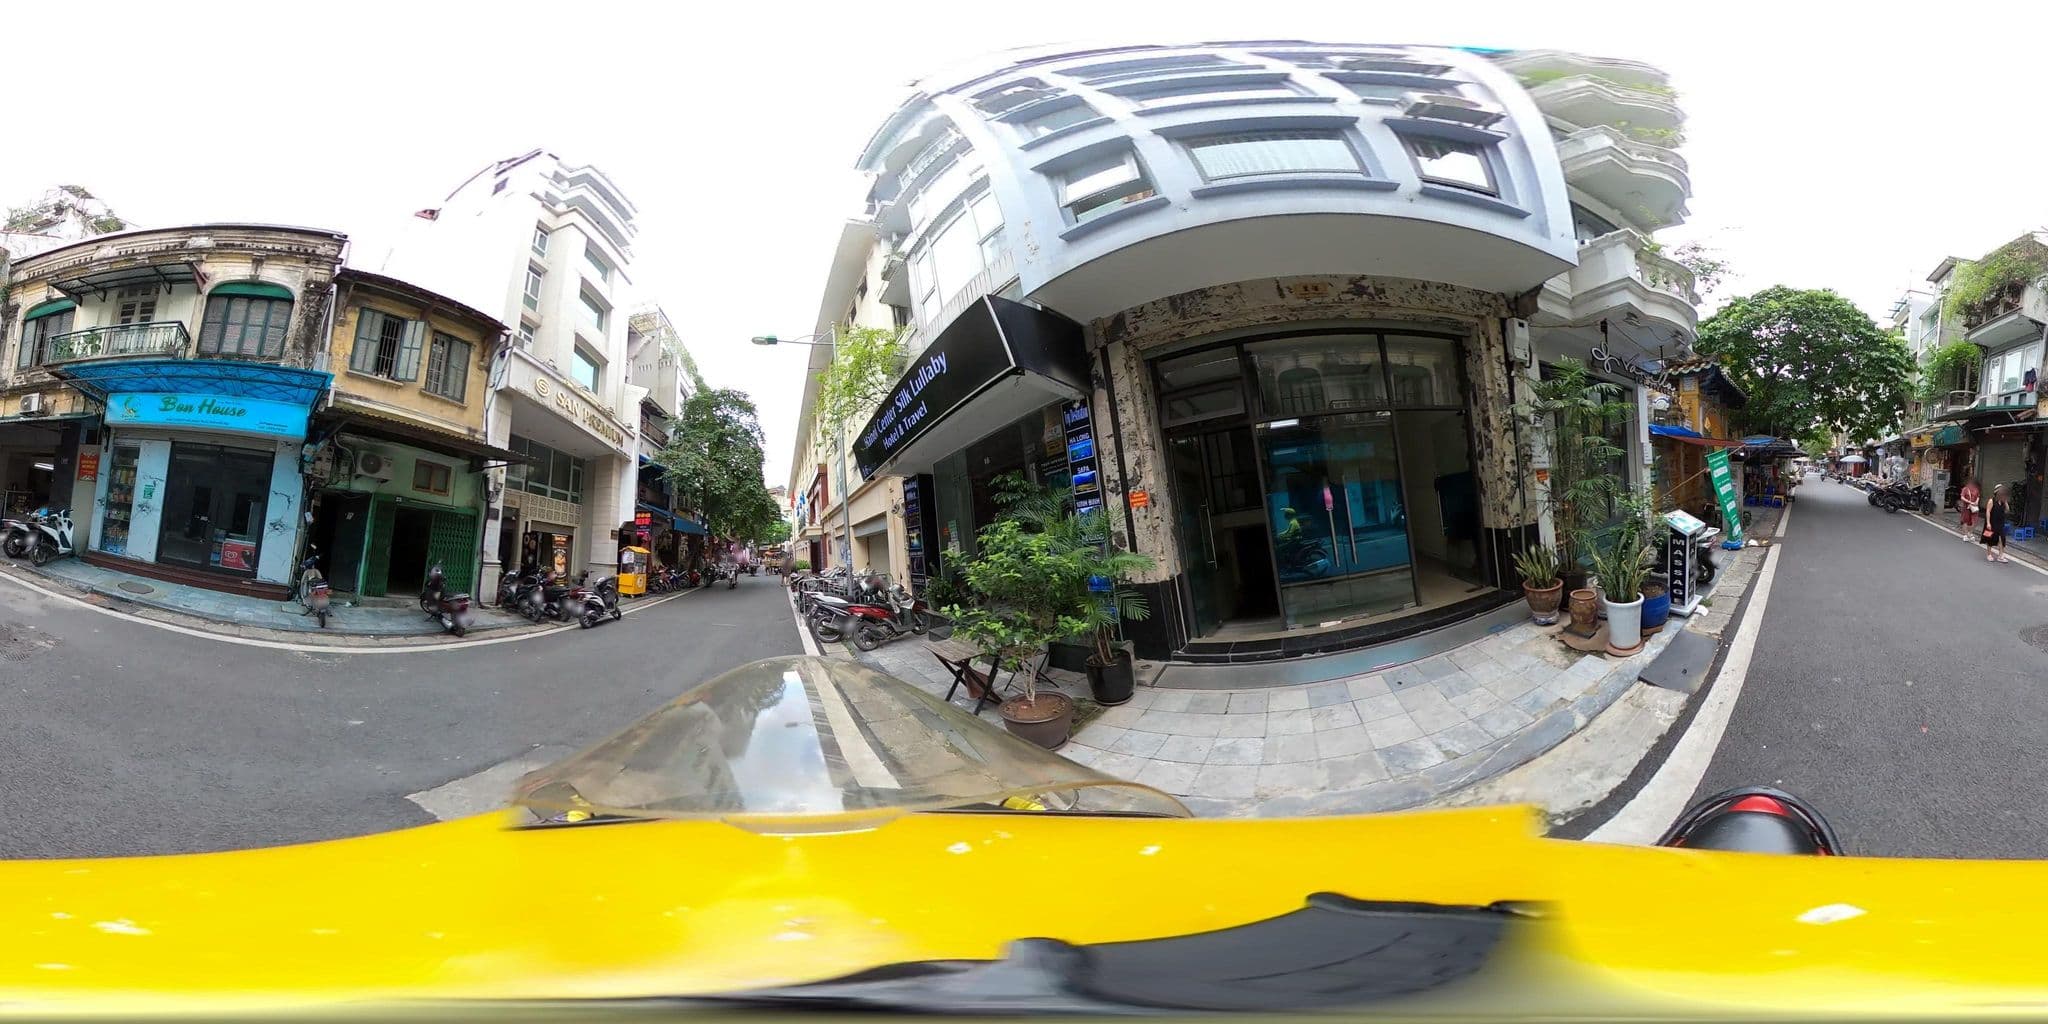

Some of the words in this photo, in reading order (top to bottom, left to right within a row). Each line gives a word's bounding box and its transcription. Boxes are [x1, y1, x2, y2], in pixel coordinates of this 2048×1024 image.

[198, 399, 247, 417] House
[876, 405, 898, 433] Center
[894, 388, 913, 413] Silk
[909, 351, 948, 396] Lullaby
[556, 391, 580, 417] SAN
[583, 408, 624, 447] PREMIUM
[882, 427, 899, 450] Hotel
[903, 400, 928, 431] Travel
